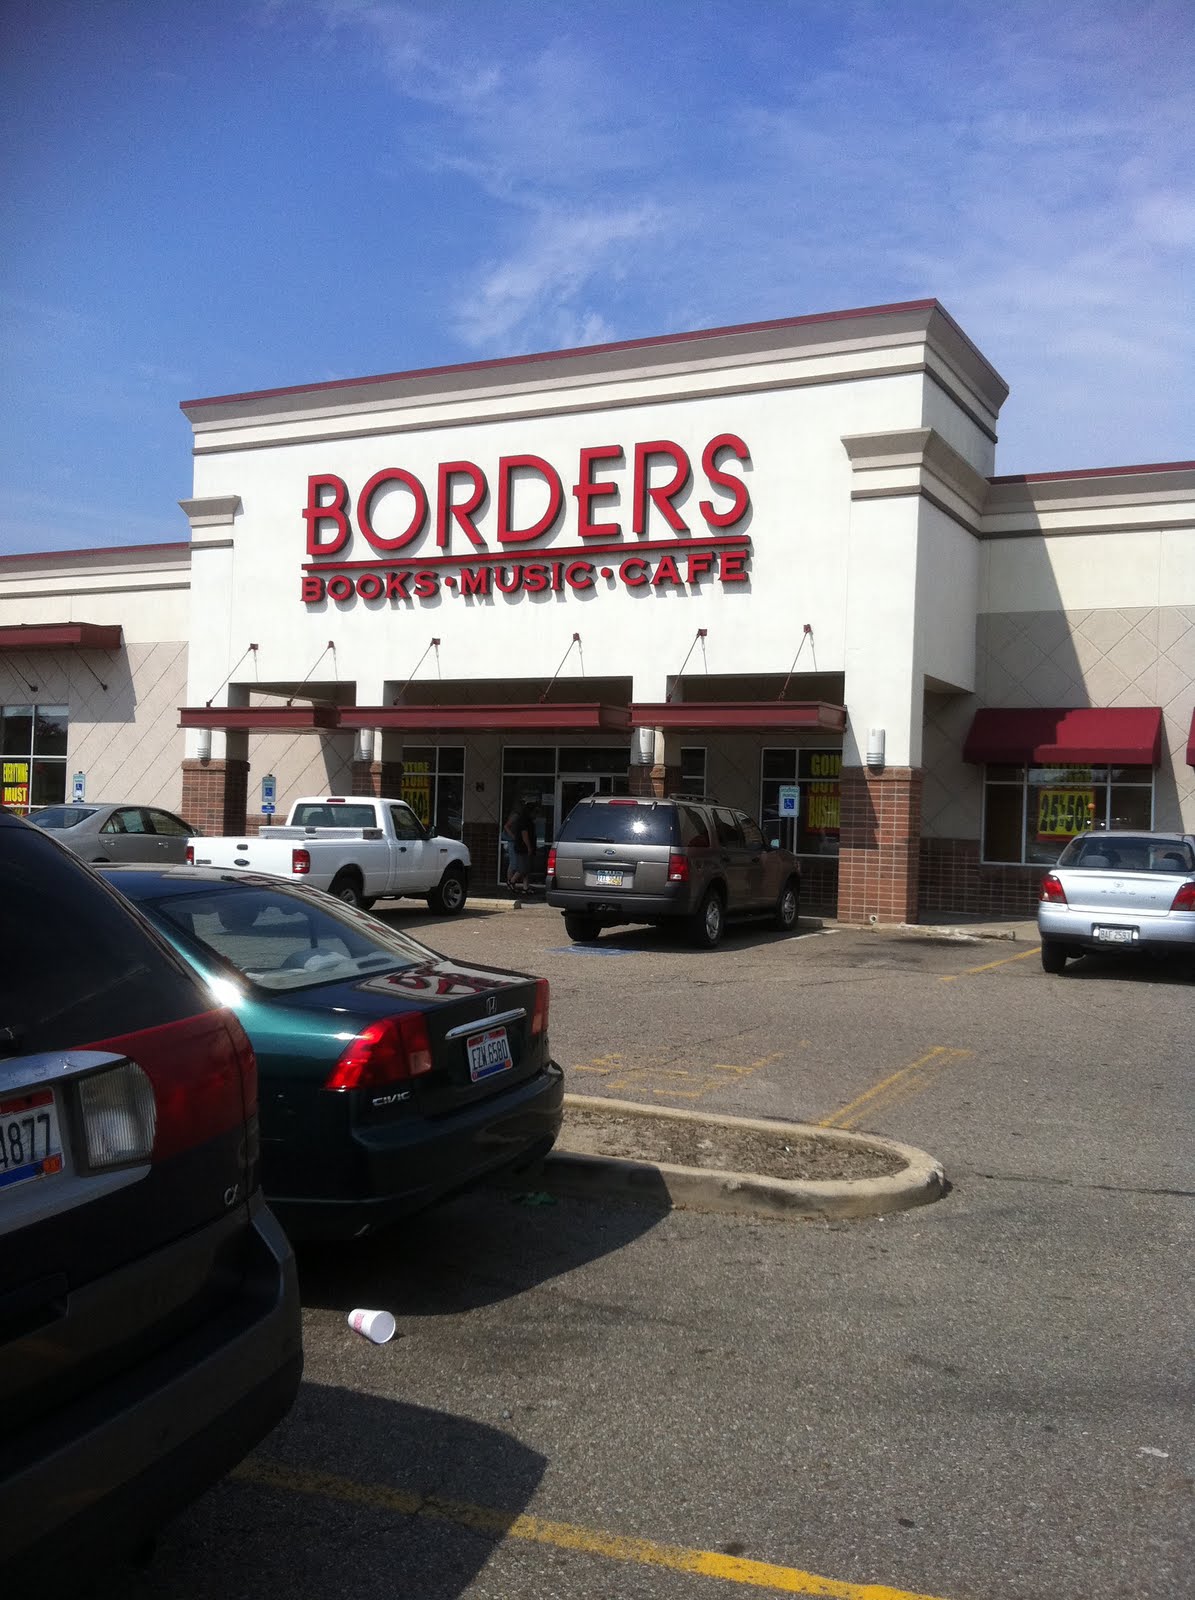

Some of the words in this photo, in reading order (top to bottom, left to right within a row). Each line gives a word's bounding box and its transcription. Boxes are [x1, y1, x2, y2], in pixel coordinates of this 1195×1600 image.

[302, 433, 751, 556] BORDERS
[300, 566, 439, 603] BOOKS
[459, 559, 595, 597] MUSIC
[618, 548, 750, 587] CAFE
[4, 787, 28, 802] MUST
[487, 1038, 509, 1064] 6580
[372, 1091, 410, 1106] CIVIC
